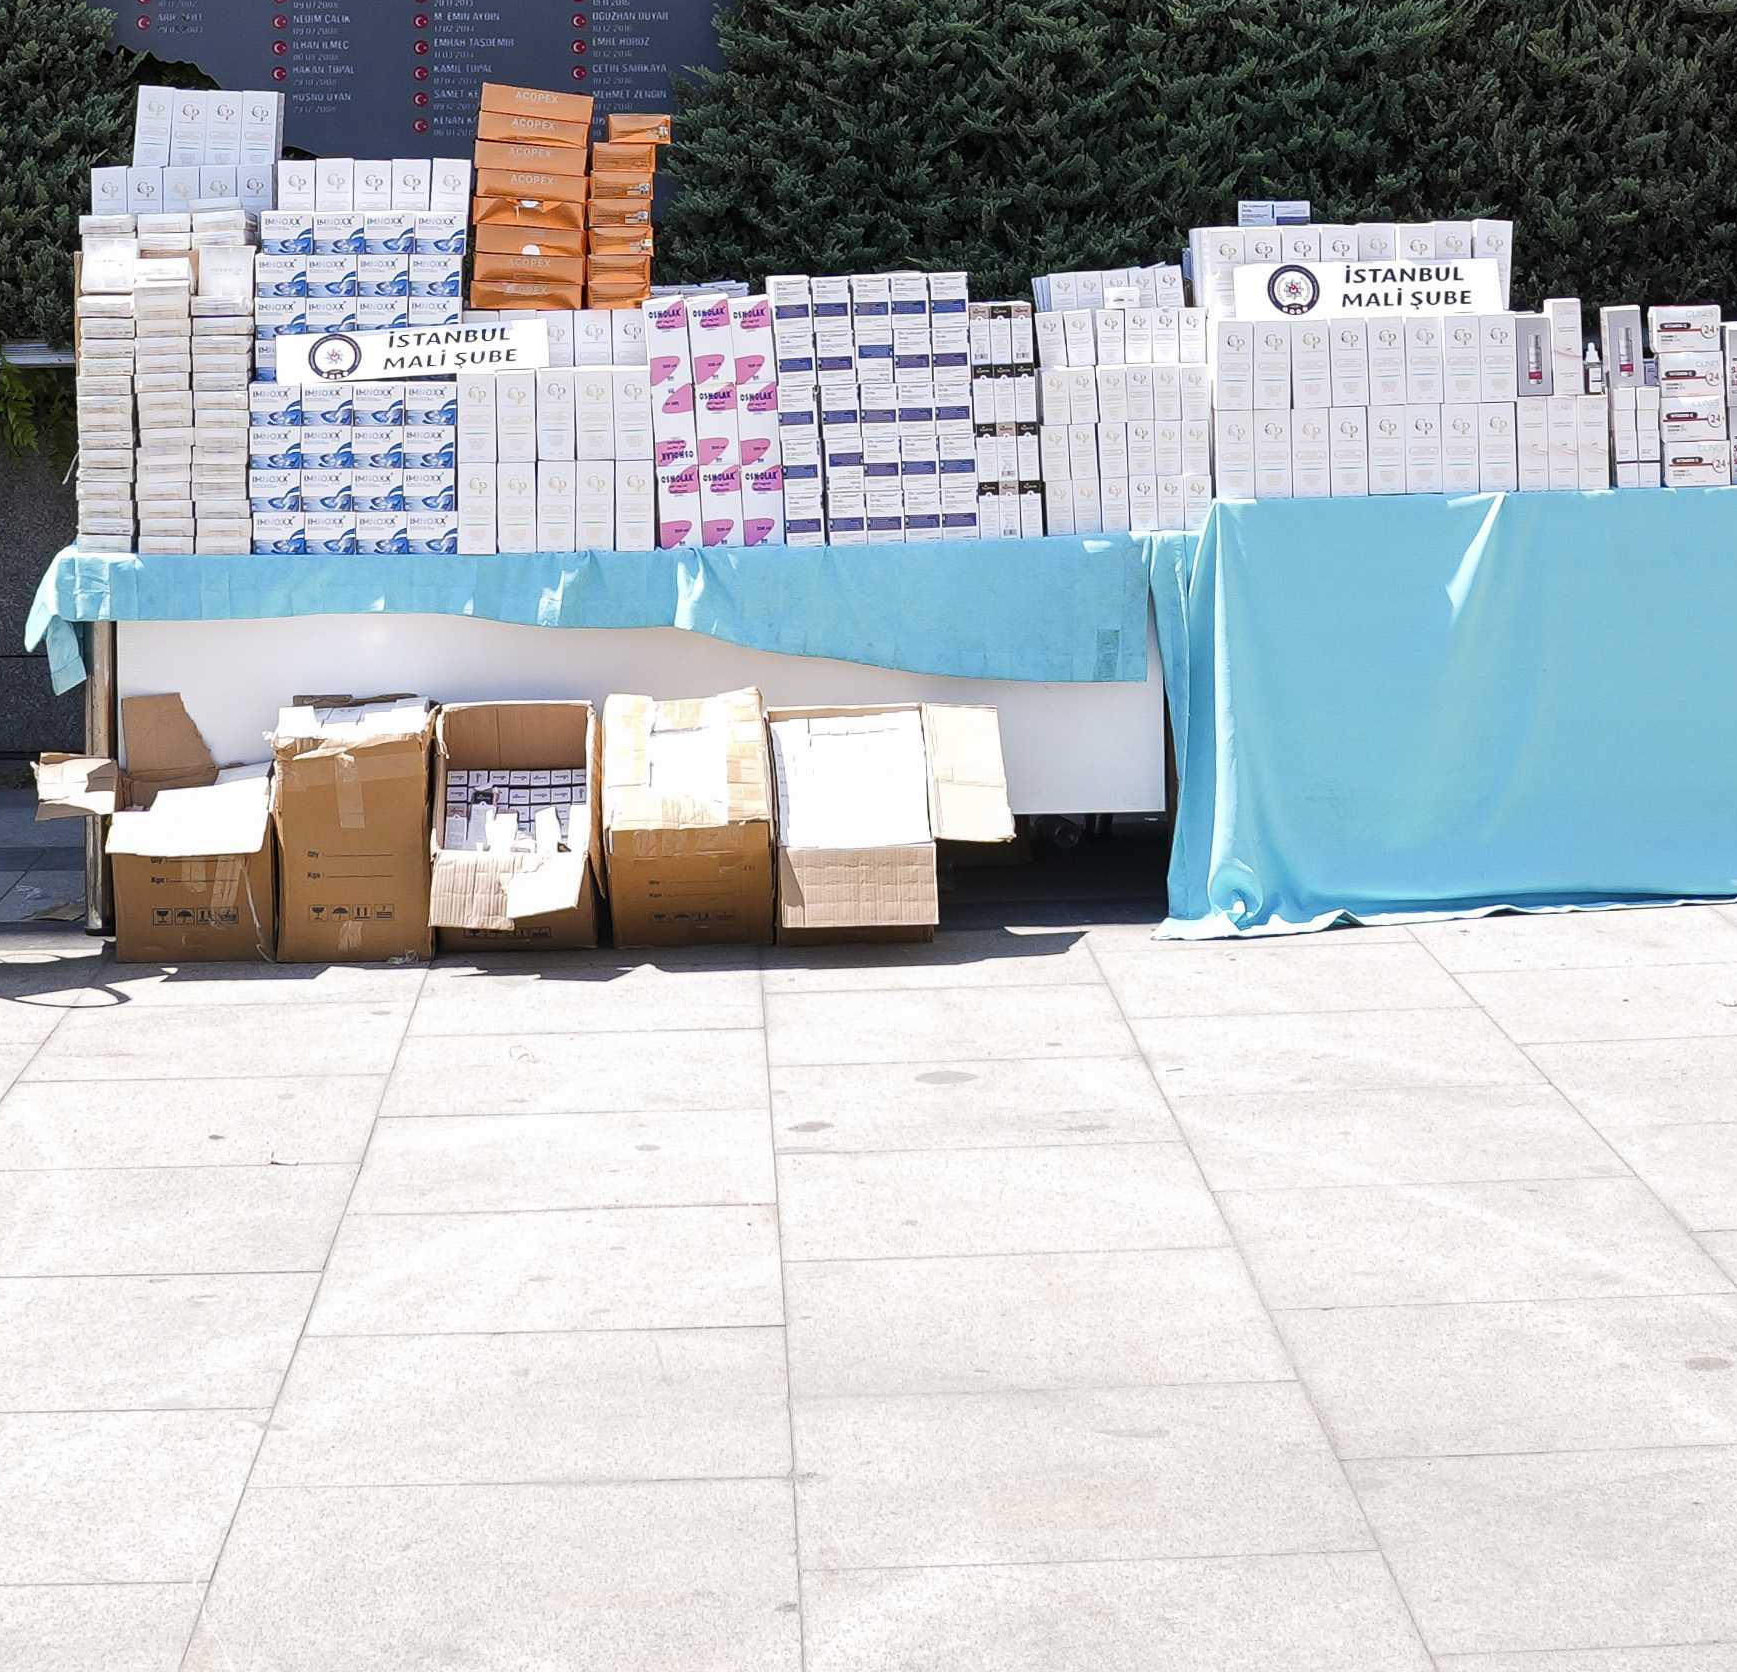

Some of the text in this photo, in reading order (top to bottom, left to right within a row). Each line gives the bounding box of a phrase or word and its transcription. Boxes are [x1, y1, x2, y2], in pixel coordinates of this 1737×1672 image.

[515, 91, 559, 104] ACOPEX
[510, 118, 557, 131] ACOPEX
[1345, 265, 1464, 284] İSTANBUL
[1342, 287, 1472, 310] MALİ ŞUBE
[389, 327, 510, 348] İSTANBUL
[384, 349, 518, 370] MALİ ŞUBE
